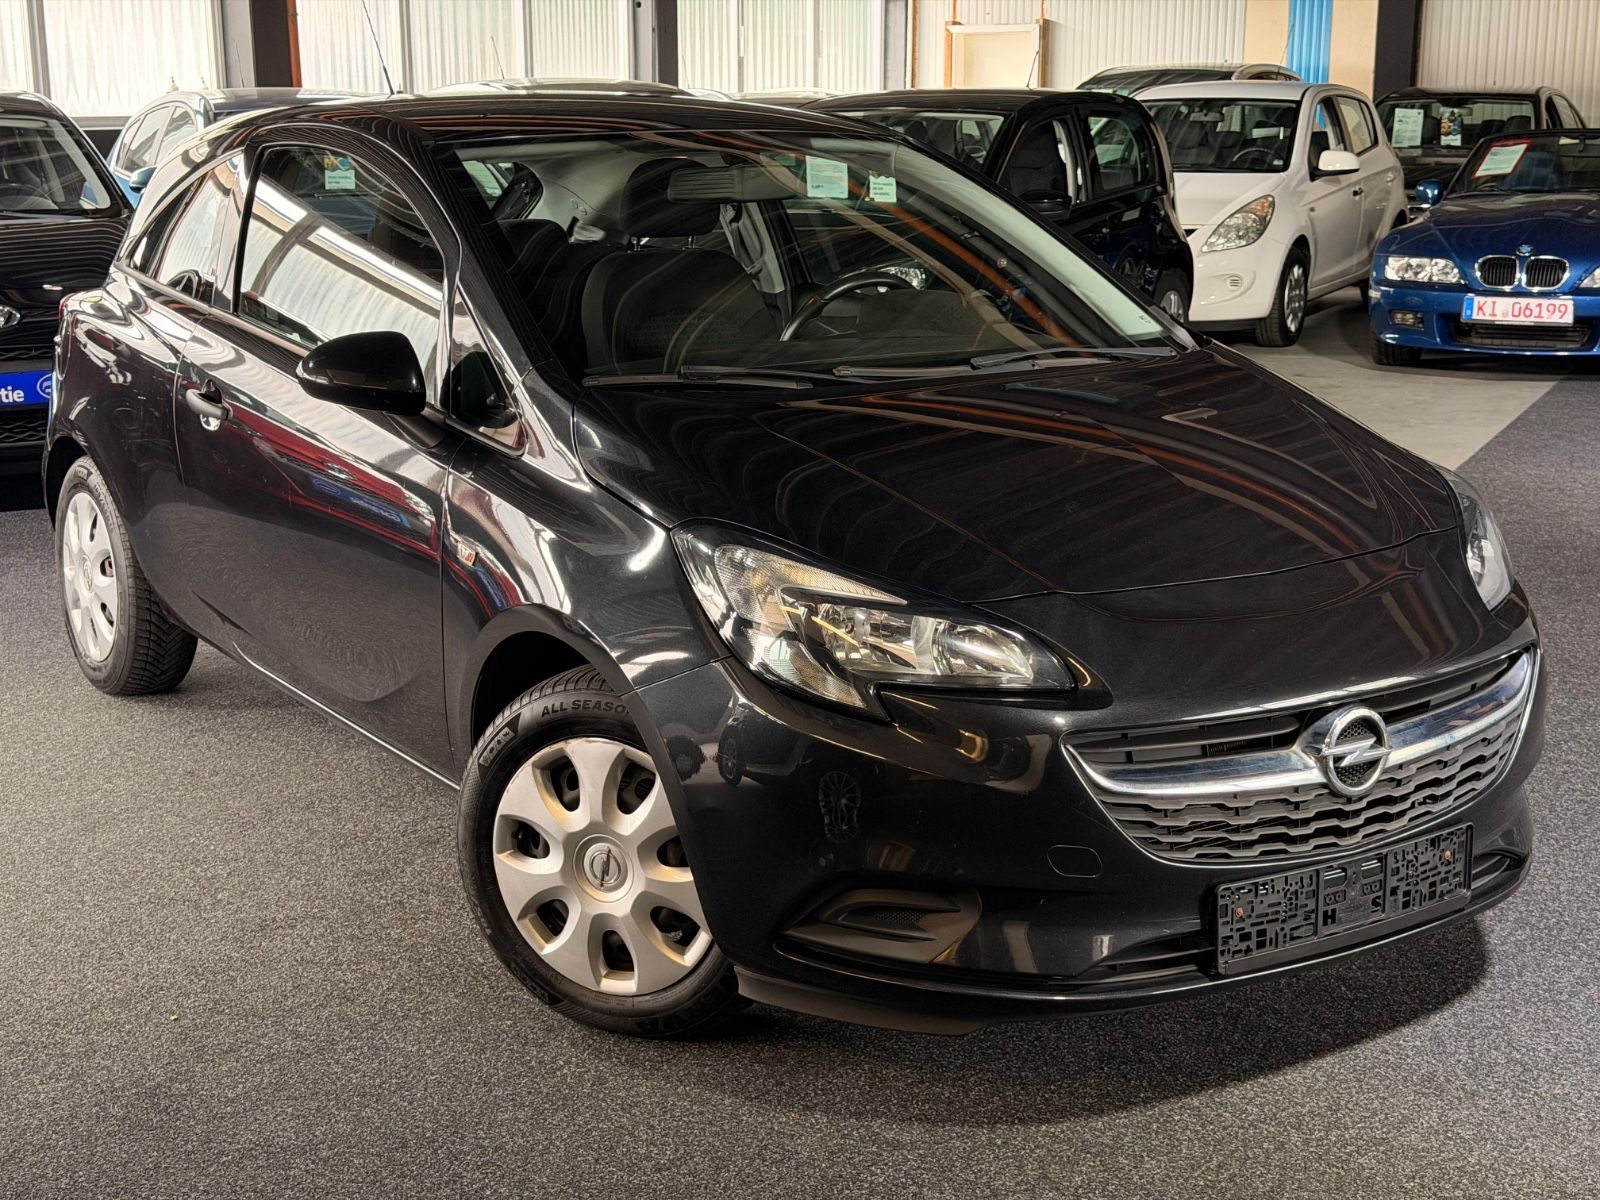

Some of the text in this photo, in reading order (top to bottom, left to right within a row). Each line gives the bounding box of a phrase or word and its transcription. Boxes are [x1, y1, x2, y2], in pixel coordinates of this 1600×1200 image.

[1476, 301, 1568, 319] KI 06199
[541, 699, 630, 717] ALL SEASO
